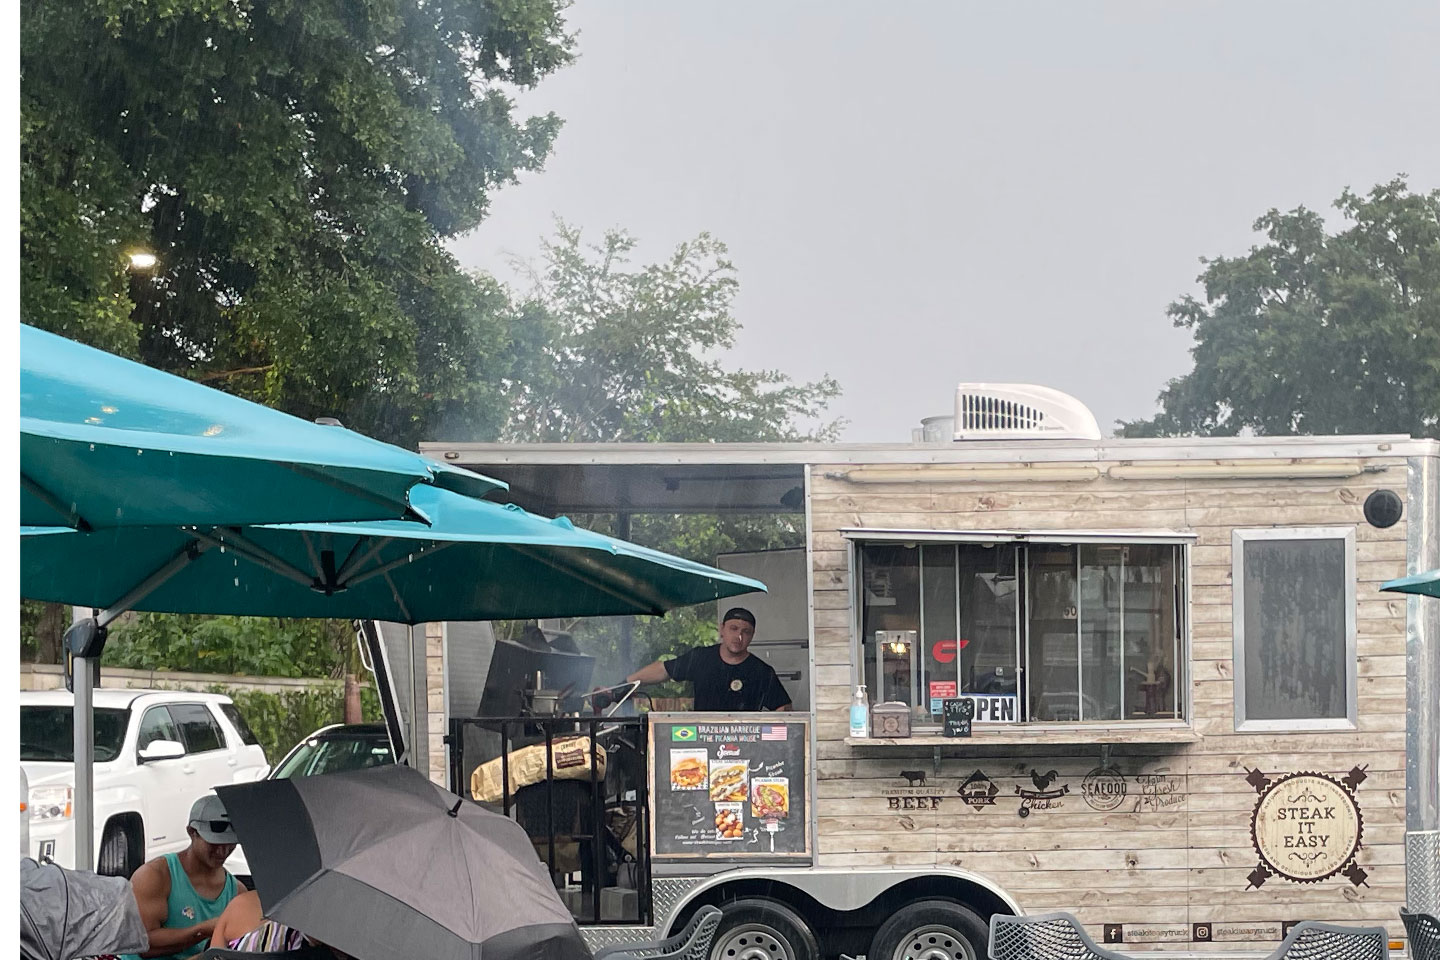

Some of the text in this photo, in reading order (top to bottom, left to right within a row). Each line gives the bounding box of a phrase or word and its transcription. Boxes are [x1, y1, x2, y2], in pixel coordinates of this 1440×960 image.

[698, 725, 760, 734] BRAZILIAN BARBECUE
[1081, 782, 1127, 795] SEAFOOD
[887, 797, 943, 811] BEEF
[1021, 798, 1064, 810] Chicken
[1277, 806, 1336, 819] STEAK
[1298, 822, 1315, 834] IT
[1284, 835, 1330, 848] EASY
